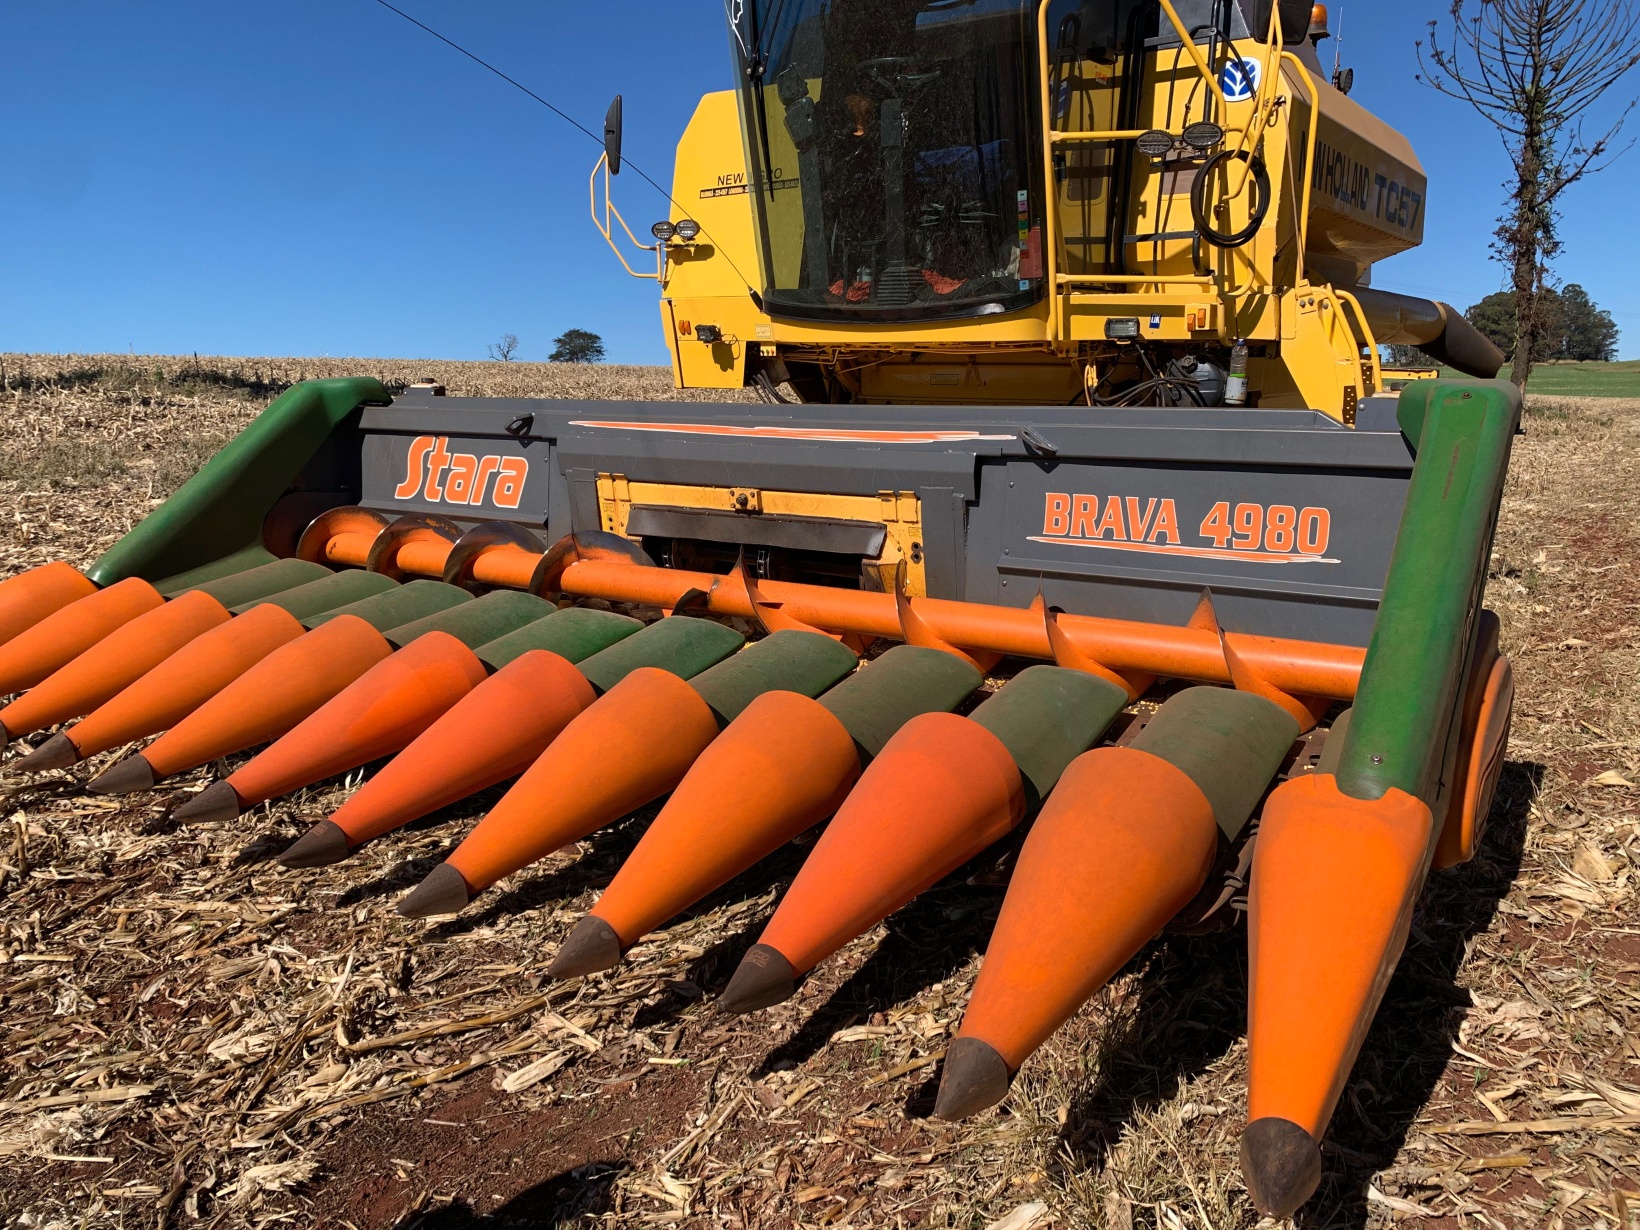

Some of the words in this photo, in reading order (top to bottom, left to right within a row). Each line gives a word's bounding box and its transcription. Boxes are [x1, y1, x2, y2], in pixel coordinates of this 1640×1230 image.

[717, 172, 744, 186] NEW
[1298, 130, 1327, 191] NW
[1324, 145, 1370, 211] HOLLAND
[1374, 172, 1422, 231] TC57
[394, 435, 529, 509] Stara
[1042, 492, 1181, 544] BRAVA
[1199, 501, 1331, 556] 4980
